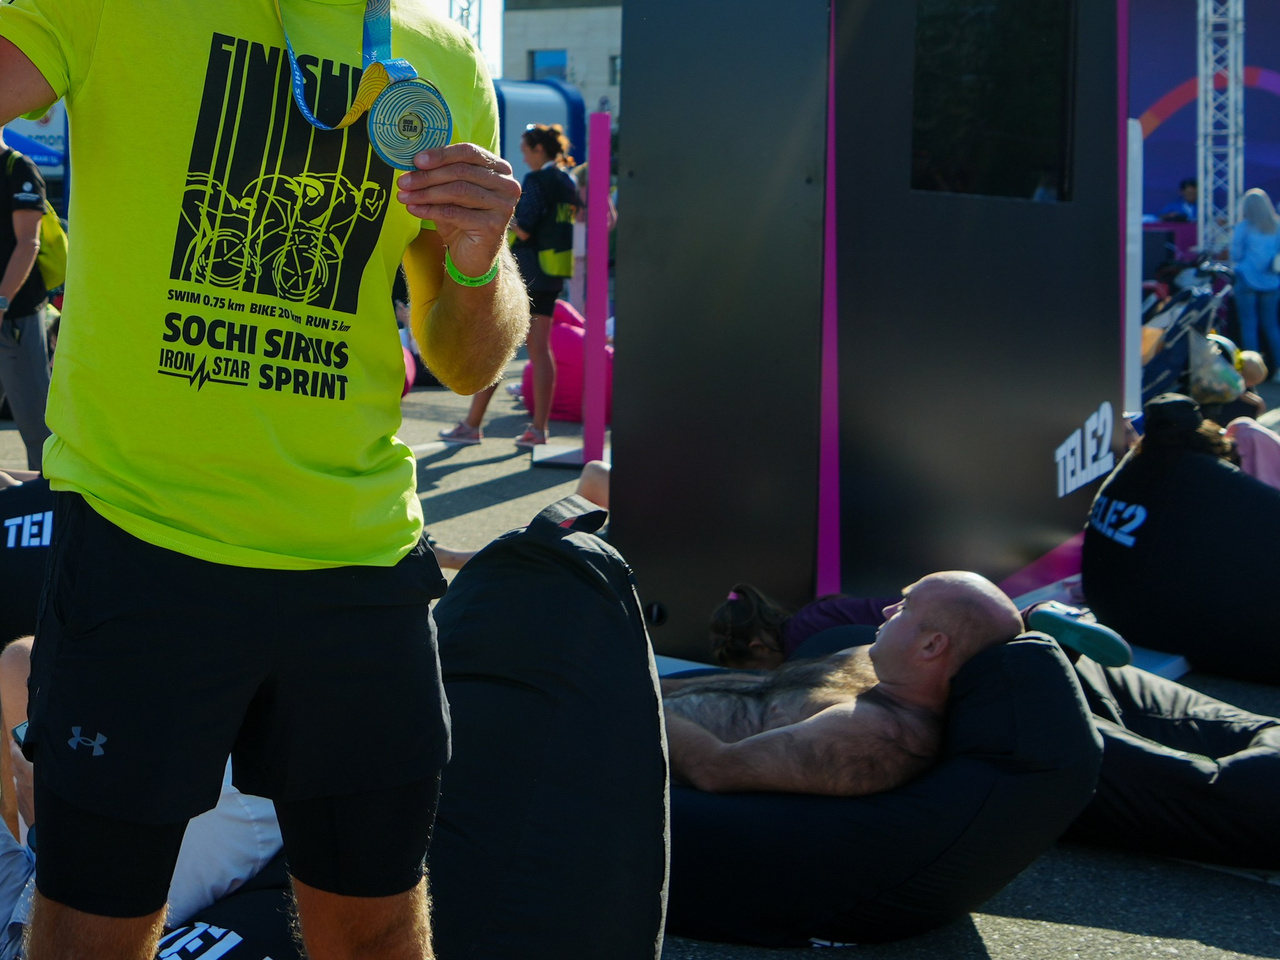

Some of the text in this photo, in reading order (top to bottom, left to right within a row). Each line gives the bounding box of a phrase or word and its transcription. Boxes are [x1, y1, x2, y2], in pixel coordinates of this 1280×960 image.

[167, 289, 351, 332] SWIM 0.75 km BIKE 20 km RUN 5 km
[162, 312, 349, 369] SOCHI SIRIUS
[159, 348, 349, 401] IRON STAR SPRINT
[1055, 401, 1114, 498] TELE2
